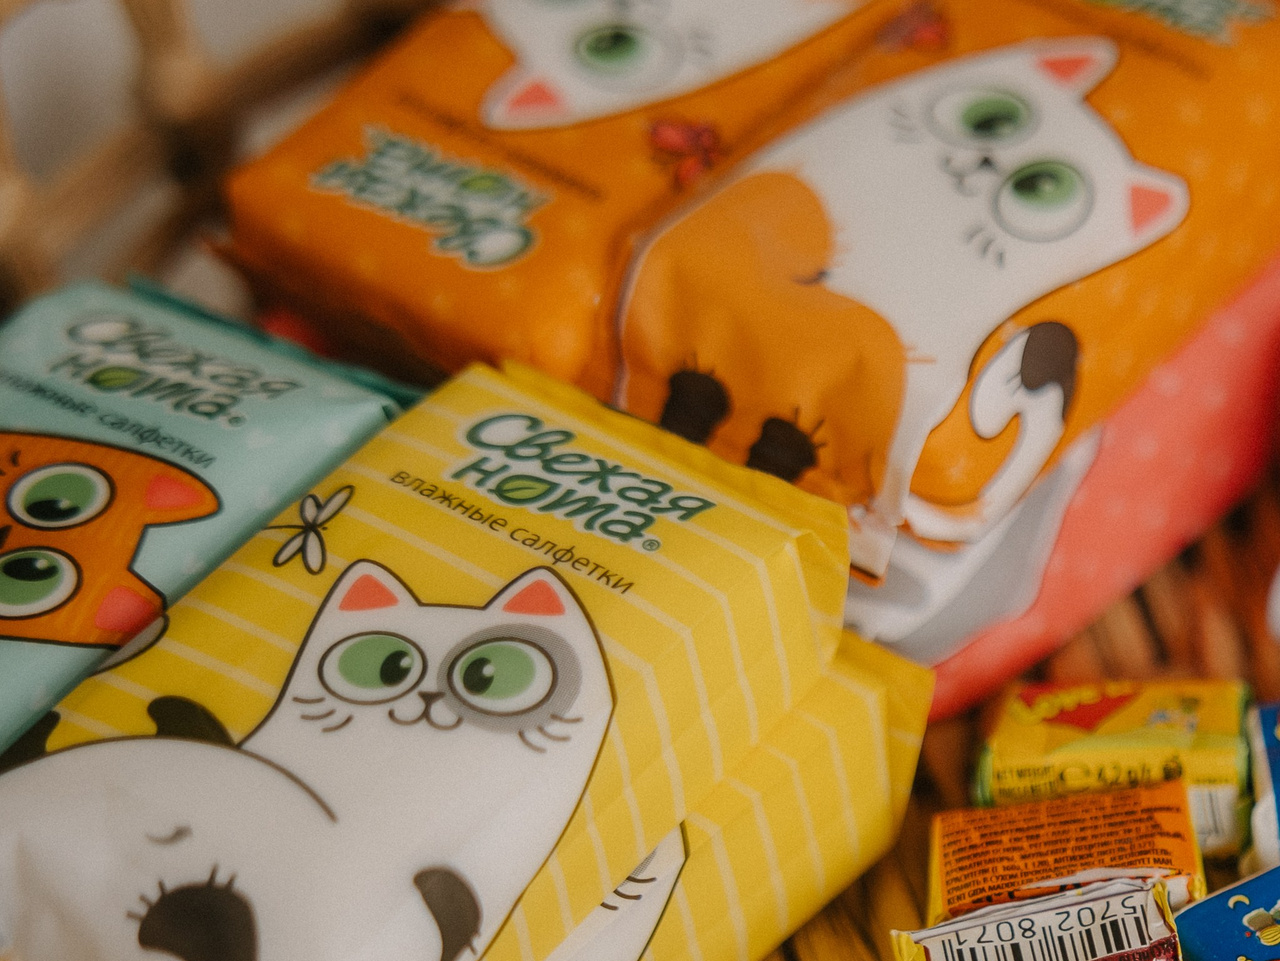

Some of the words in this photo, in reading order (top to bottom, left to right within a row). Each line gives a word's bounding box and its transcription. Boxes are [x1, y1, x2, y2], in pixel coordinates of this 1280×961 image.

[465, 413, 718, 522] Свежая
[389, 470, 509, 533] влажные
[509, 523, 635, 595] салфетки
[953, 917, 1037, 949] 8071
[1052, 894, 1139, 933] 5702
